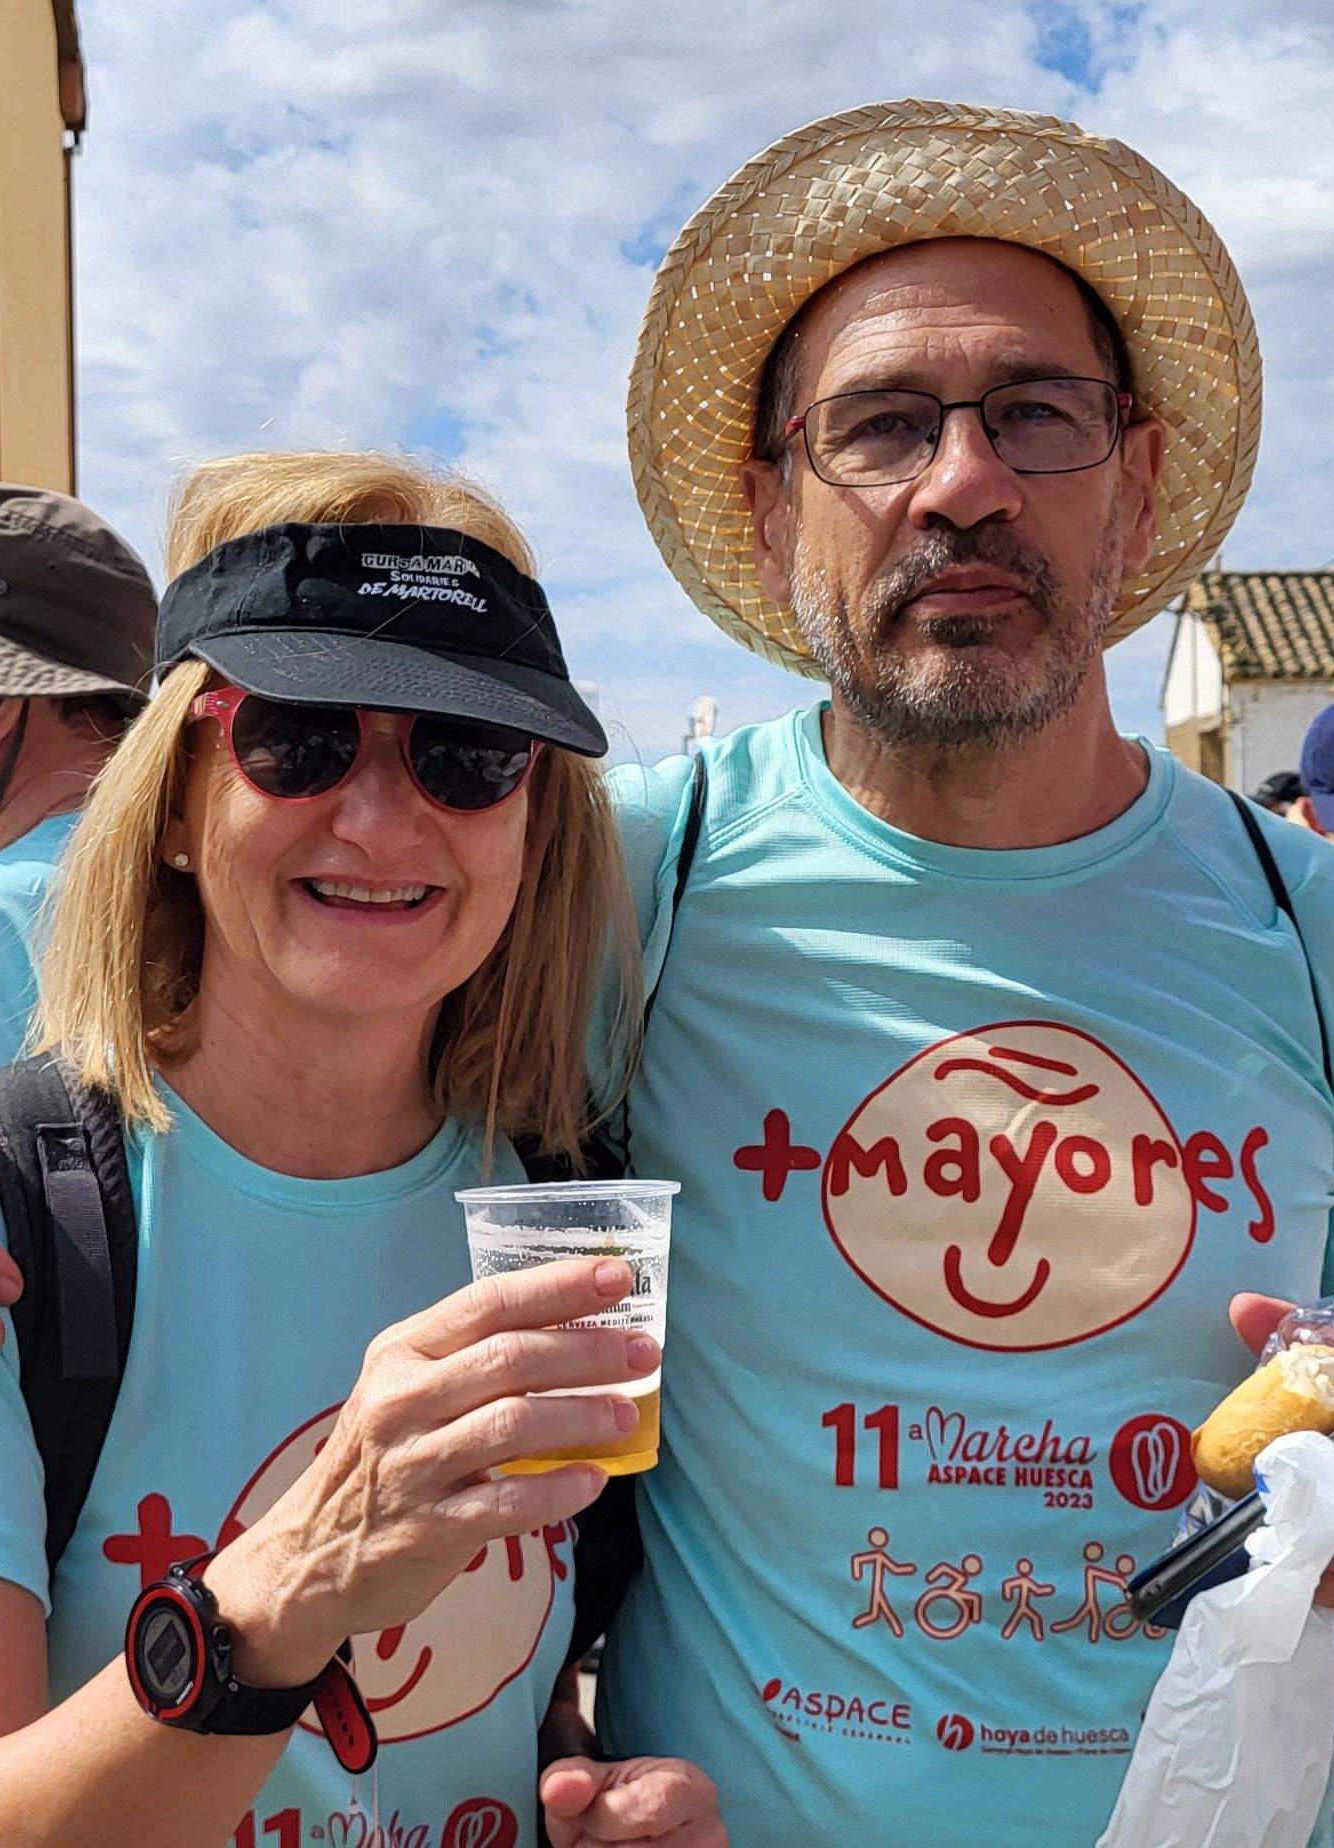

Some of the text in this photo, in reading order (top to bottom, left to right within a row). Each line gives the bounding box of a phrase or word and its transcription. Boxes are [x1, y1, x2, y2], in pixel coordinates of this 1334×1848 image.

[362, 553, 424, 572] CURSA
[357, 582, 488, 613] DE MARTORELL
[924, 1405, 1099, 1466] Marcha
[927, 1464, 1093, 1491] ASPACE HUESCA
[1044, 1491, 1093, 1510] 2023
